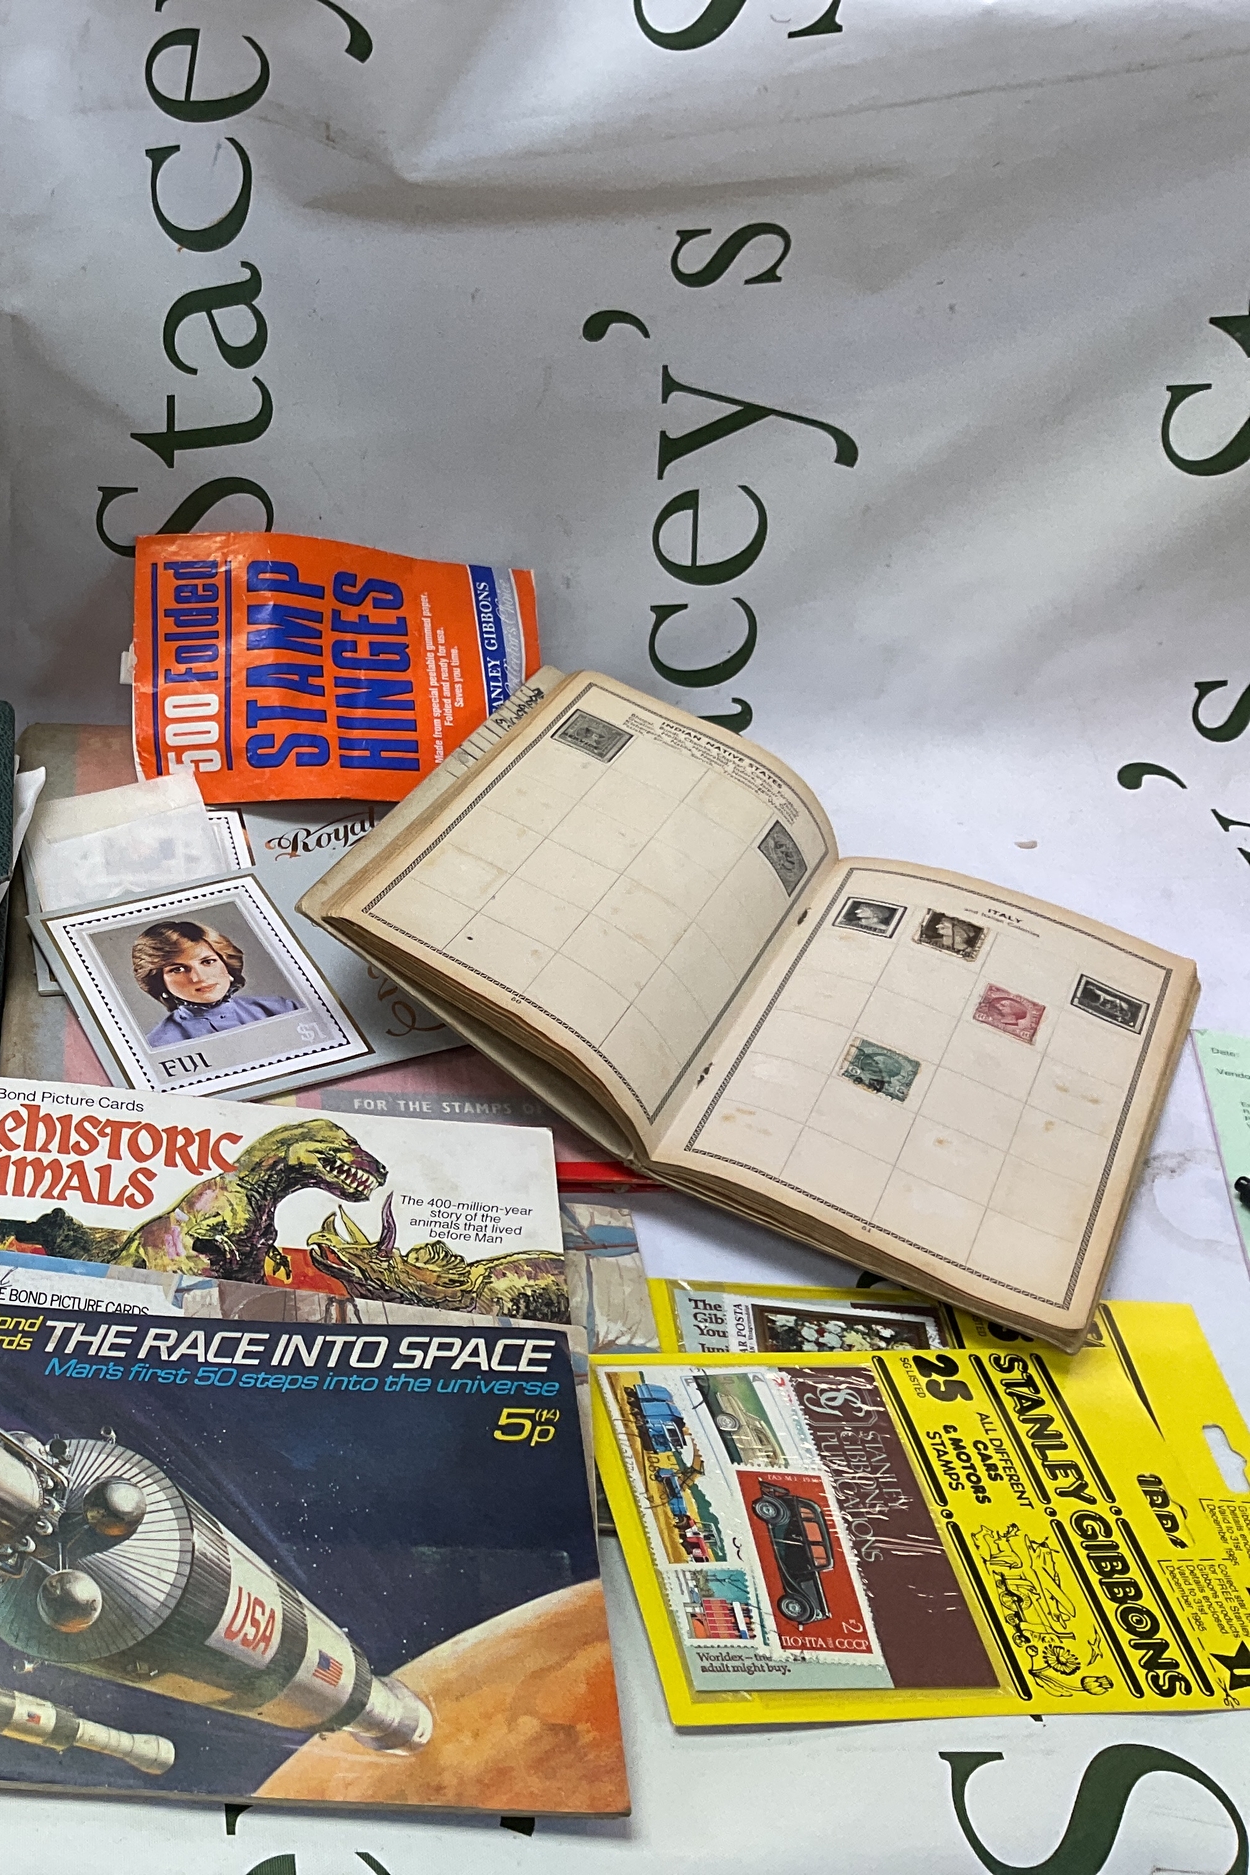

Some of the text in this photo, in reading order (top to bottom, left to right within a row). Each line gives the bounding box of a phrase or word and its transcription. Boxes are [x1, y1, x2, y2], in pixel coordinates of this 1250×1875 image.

[476, 581, 498, 651] GIBBONS
[422, 617, 435, 650] gummed
[163, 559, 222, 773] 500 Folded
[246, 560, 331, 768] STAMP
[330, 571, 420, 772] HINGES
[423, 651, 437, 686] peelable
[452, 667, 463, 682] you
[429, 686, 441, 718] special
[438, 658, 454, 726] Folded and ready
[453, 682, 464, 707] Saves
[432, 718, 442, 739] from
[434, 740, 444, 763] Made
[661, 721, 783, 789] INDIAN NATIVE STATES
[265, 806, 377, 861] Royal
[987, 908, 1022, 923] ITALY
[297, 1022, 326, 1042] $1
[157, 1051, 213, 1079] FIJI
[41, 1091, 94, 1108] Picture
[98, 1096, 145, 1113] Cards
[353, 1098, 512, 1115] FOR THE STAMPS
[400, 1194, 533, 1218] The 400-million-year
[429, 1207, 502, 1224] story of the
[409, 1216, 523, 1236] animals that lived
[428, 1227, 504, 1245] before Man
[9, 1288, 48, 1306] BOND
[50, 1294, 104, 1312] PICTURE
[688, 1297, 723, 1312] The
[44, 1320, 556, 1373] THE RACE INTO SPACE
[44, 1357, 560, 1397] Man's first 50 steps into the universe
[899, 1356, 927, 1398] SG LISTED
[912, 1353, 974, 1402] 25
[492, 1407, 556, 1447] 5p
[926, 1430, 965, 1492] STAMPS
[948, 1437, 992, 1505] MOTORS
[972, 1439, 1004, 1482] CARS
[975, 1411, 1035, 1510] ALL DIFFERENT
[988, 1352, 1098, 1506] STANLEY
[1069, 1508, 1194, 1699] GIBBONS
[1176, 1565, 1190, 1587] Valid
[1215, 1578, 1235, 1602] FREE
[1217, 1563, 1239, 1594] Collect
[1165, 1565, 1207, 1632] December 1985
[1185, 1564, 1229, 1635] Details enclosed
[1196, 1564, 1241, 1639] Gibbons products
[223, 1585, 277, 1656] USA
[697, 1652, 744, 1662] Worldex
[700, 1662, 792, 1677] adult might buy.
